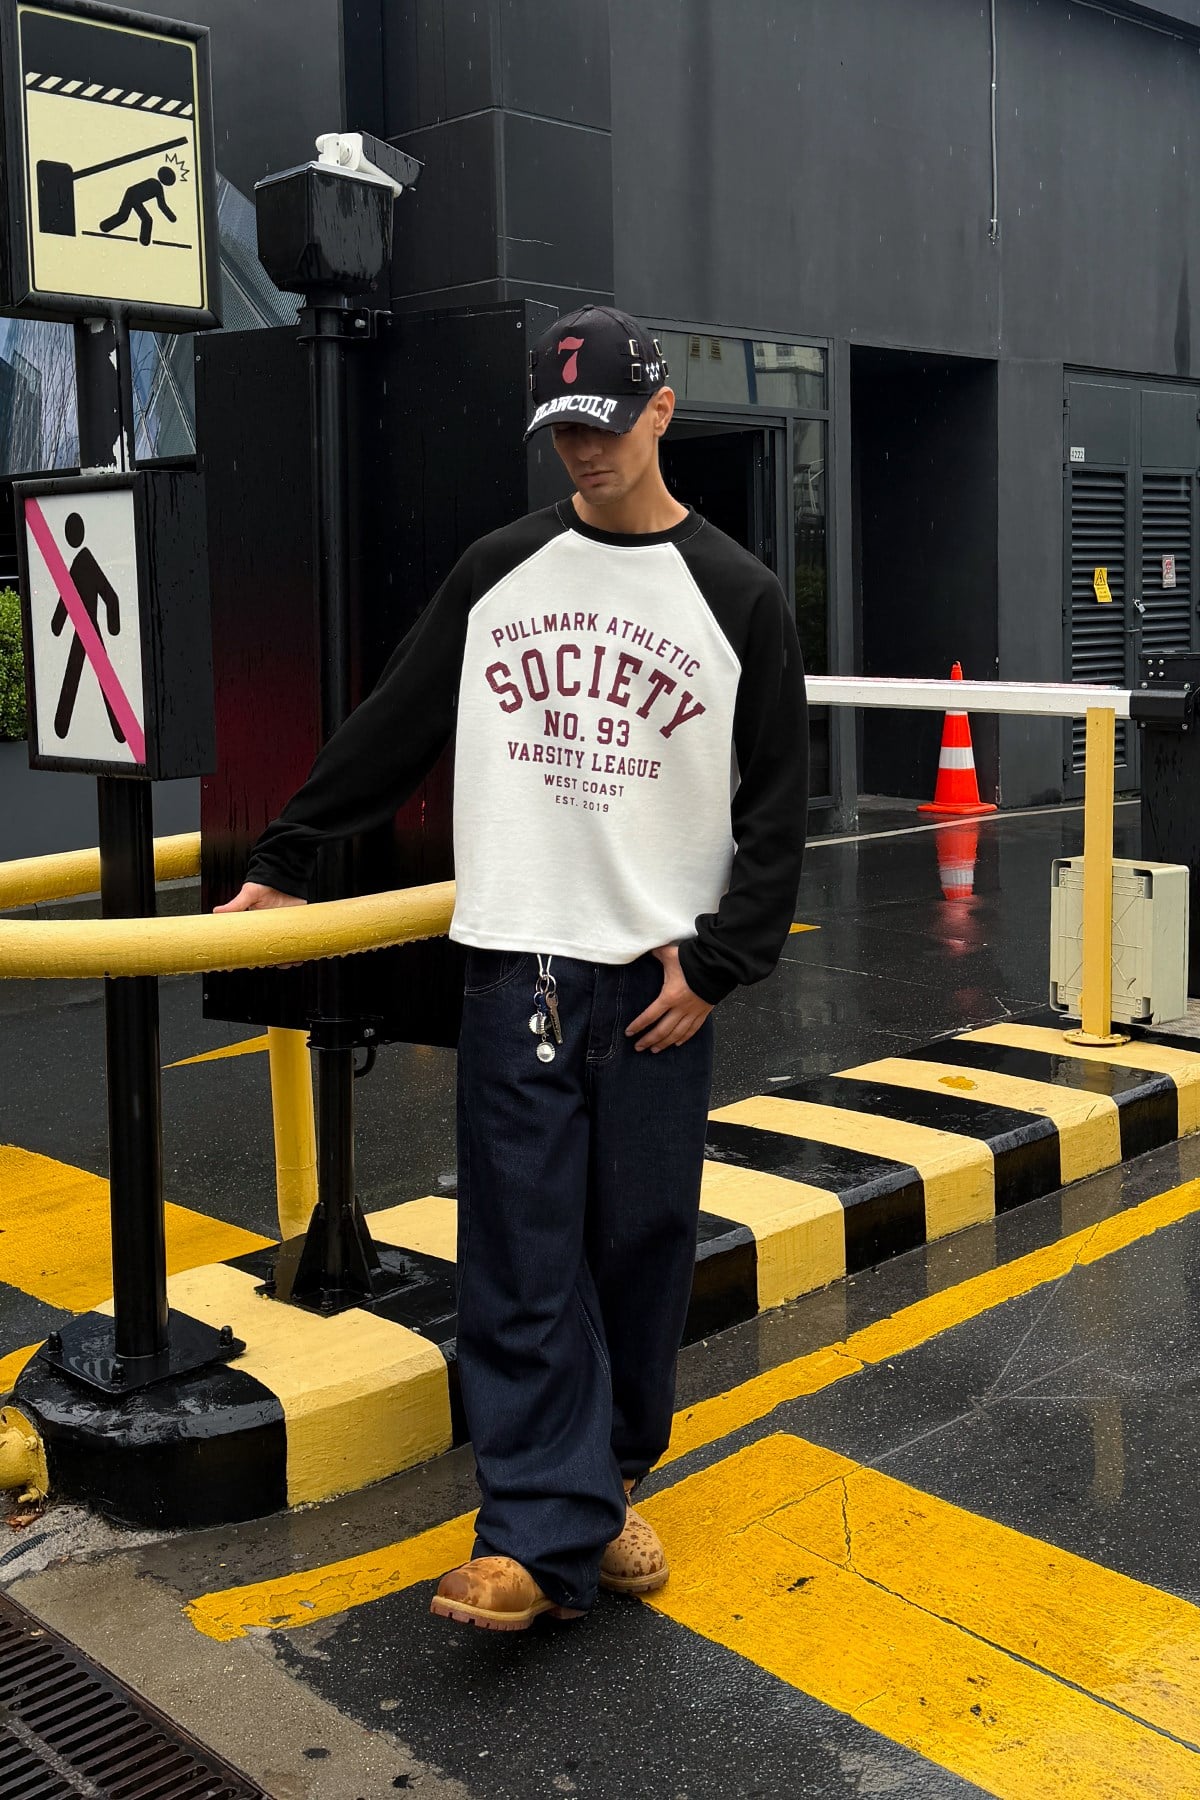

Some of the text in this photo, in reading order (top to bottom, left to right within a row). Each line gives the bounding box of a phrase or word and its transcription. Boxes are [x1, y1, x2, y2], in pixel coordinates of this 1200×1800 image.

[557, 336, 585, 384] 7
[491, 612, 701, 678] PULLMARK ATHLETIC
[485, 643, 706, 739] SOCIETY
[544, 709, 631, 747] NO. 93
[507, 741, 661, 780] VARSITY LEAGUE
[544, 774, 625, 797] WEST COAST
[555, 795, 609, 813] EST. 2019
